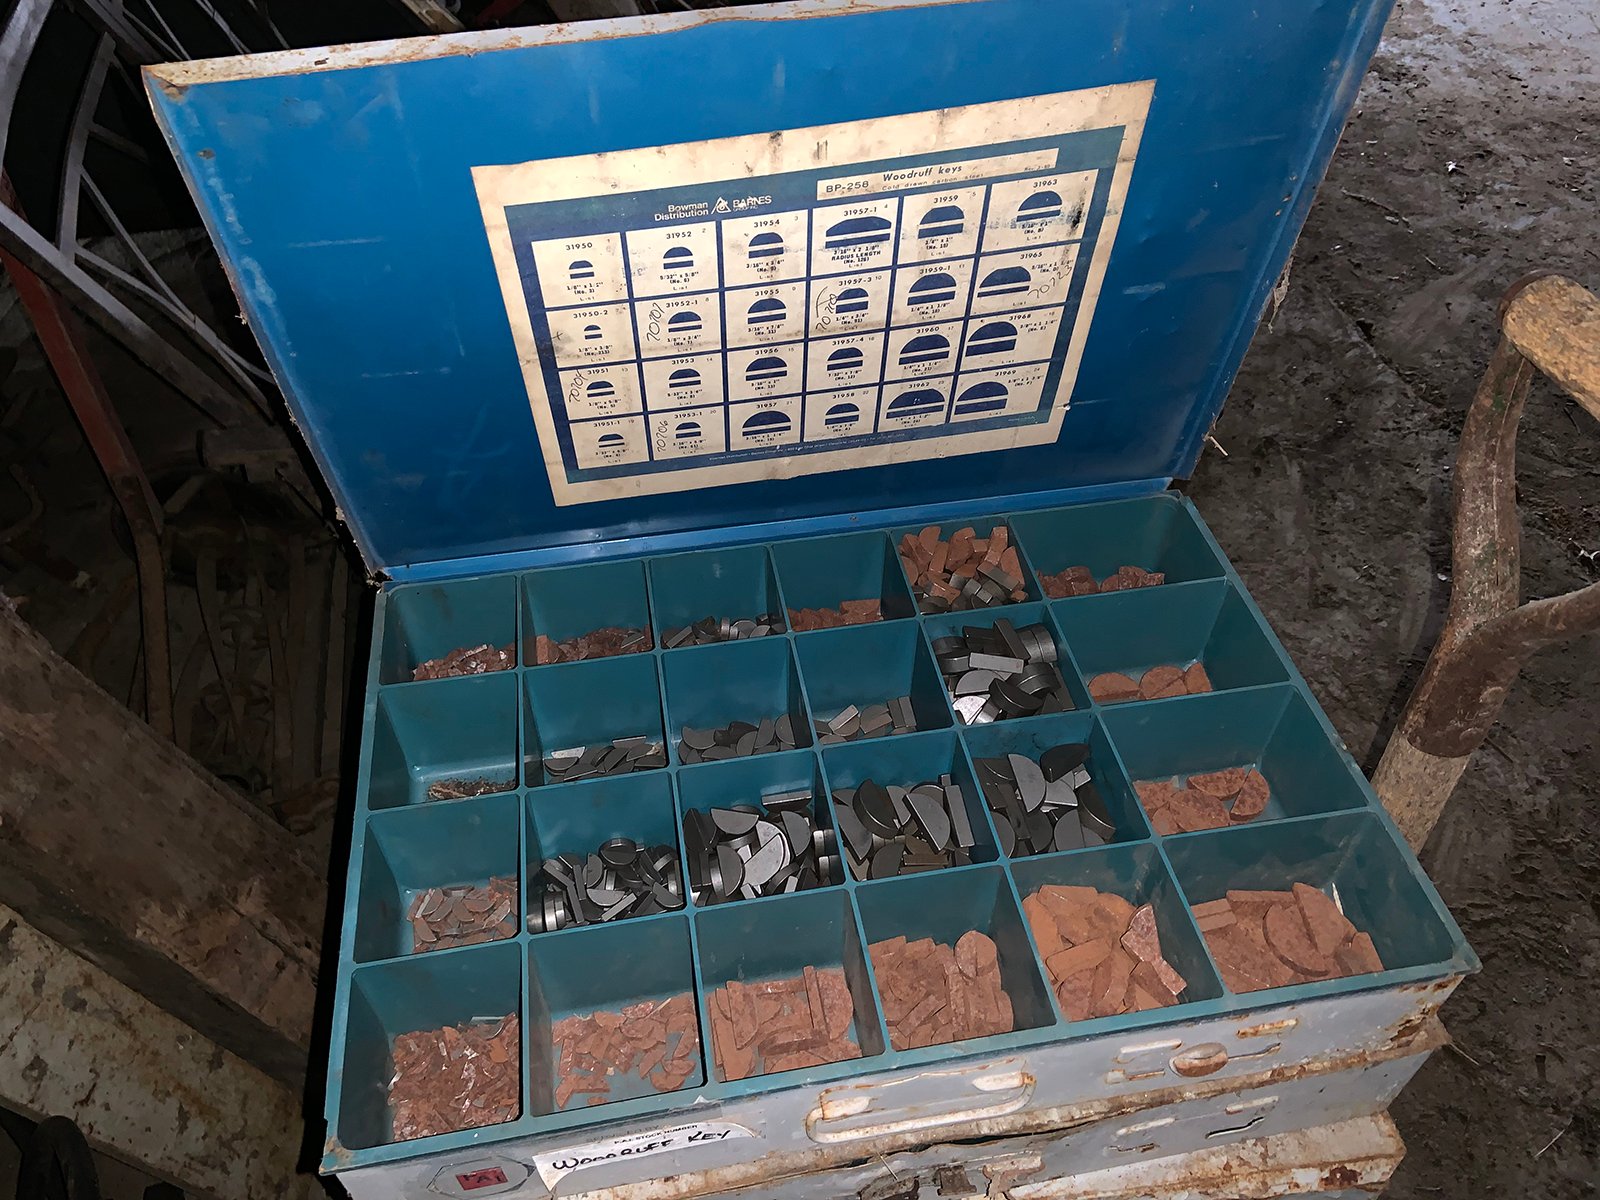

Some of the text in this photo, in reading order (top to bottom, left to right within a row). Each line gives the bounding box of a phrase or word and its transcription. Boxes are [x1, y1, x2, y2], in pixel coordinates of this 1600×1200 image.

[883, 165, 962, 182] Woodruff keys
[826, 181, 869, 193] BP-258
[1033, 179, 1057, 188] 31963
[733, 195, 772, 208] BARNES
[934, 195, 958, 204] 31959
[668, 202, 708, 213] Bowman
[844, 207, 877, 216] 31957-1
[654, 209, 709, 221] Distribution
[754, 219, 780, 228] 31954
[666, 231, 692, 239] 31952
[566, 242, 593, 251] 31950
[1020, 252, 1043, 260] 31965
[920, 265, 950, 274] 31959-1
[839, 277, 872, 287] 31957-3
[755, 289, 780, 297] 31955
[666, 300, 698, 308] 31952-1
[573, 310, 608, 319] 31950-2
[916, 326, 940, 334] 31960
[832, 337, 864, 346] 31957-4
[674, 411, 702, 419] 31953-1
[636, 1132, 662, 1140] STOCK
[664, 1125, 698, 1133] NUMBER
[687, 1129, 731, 1143] KEY
